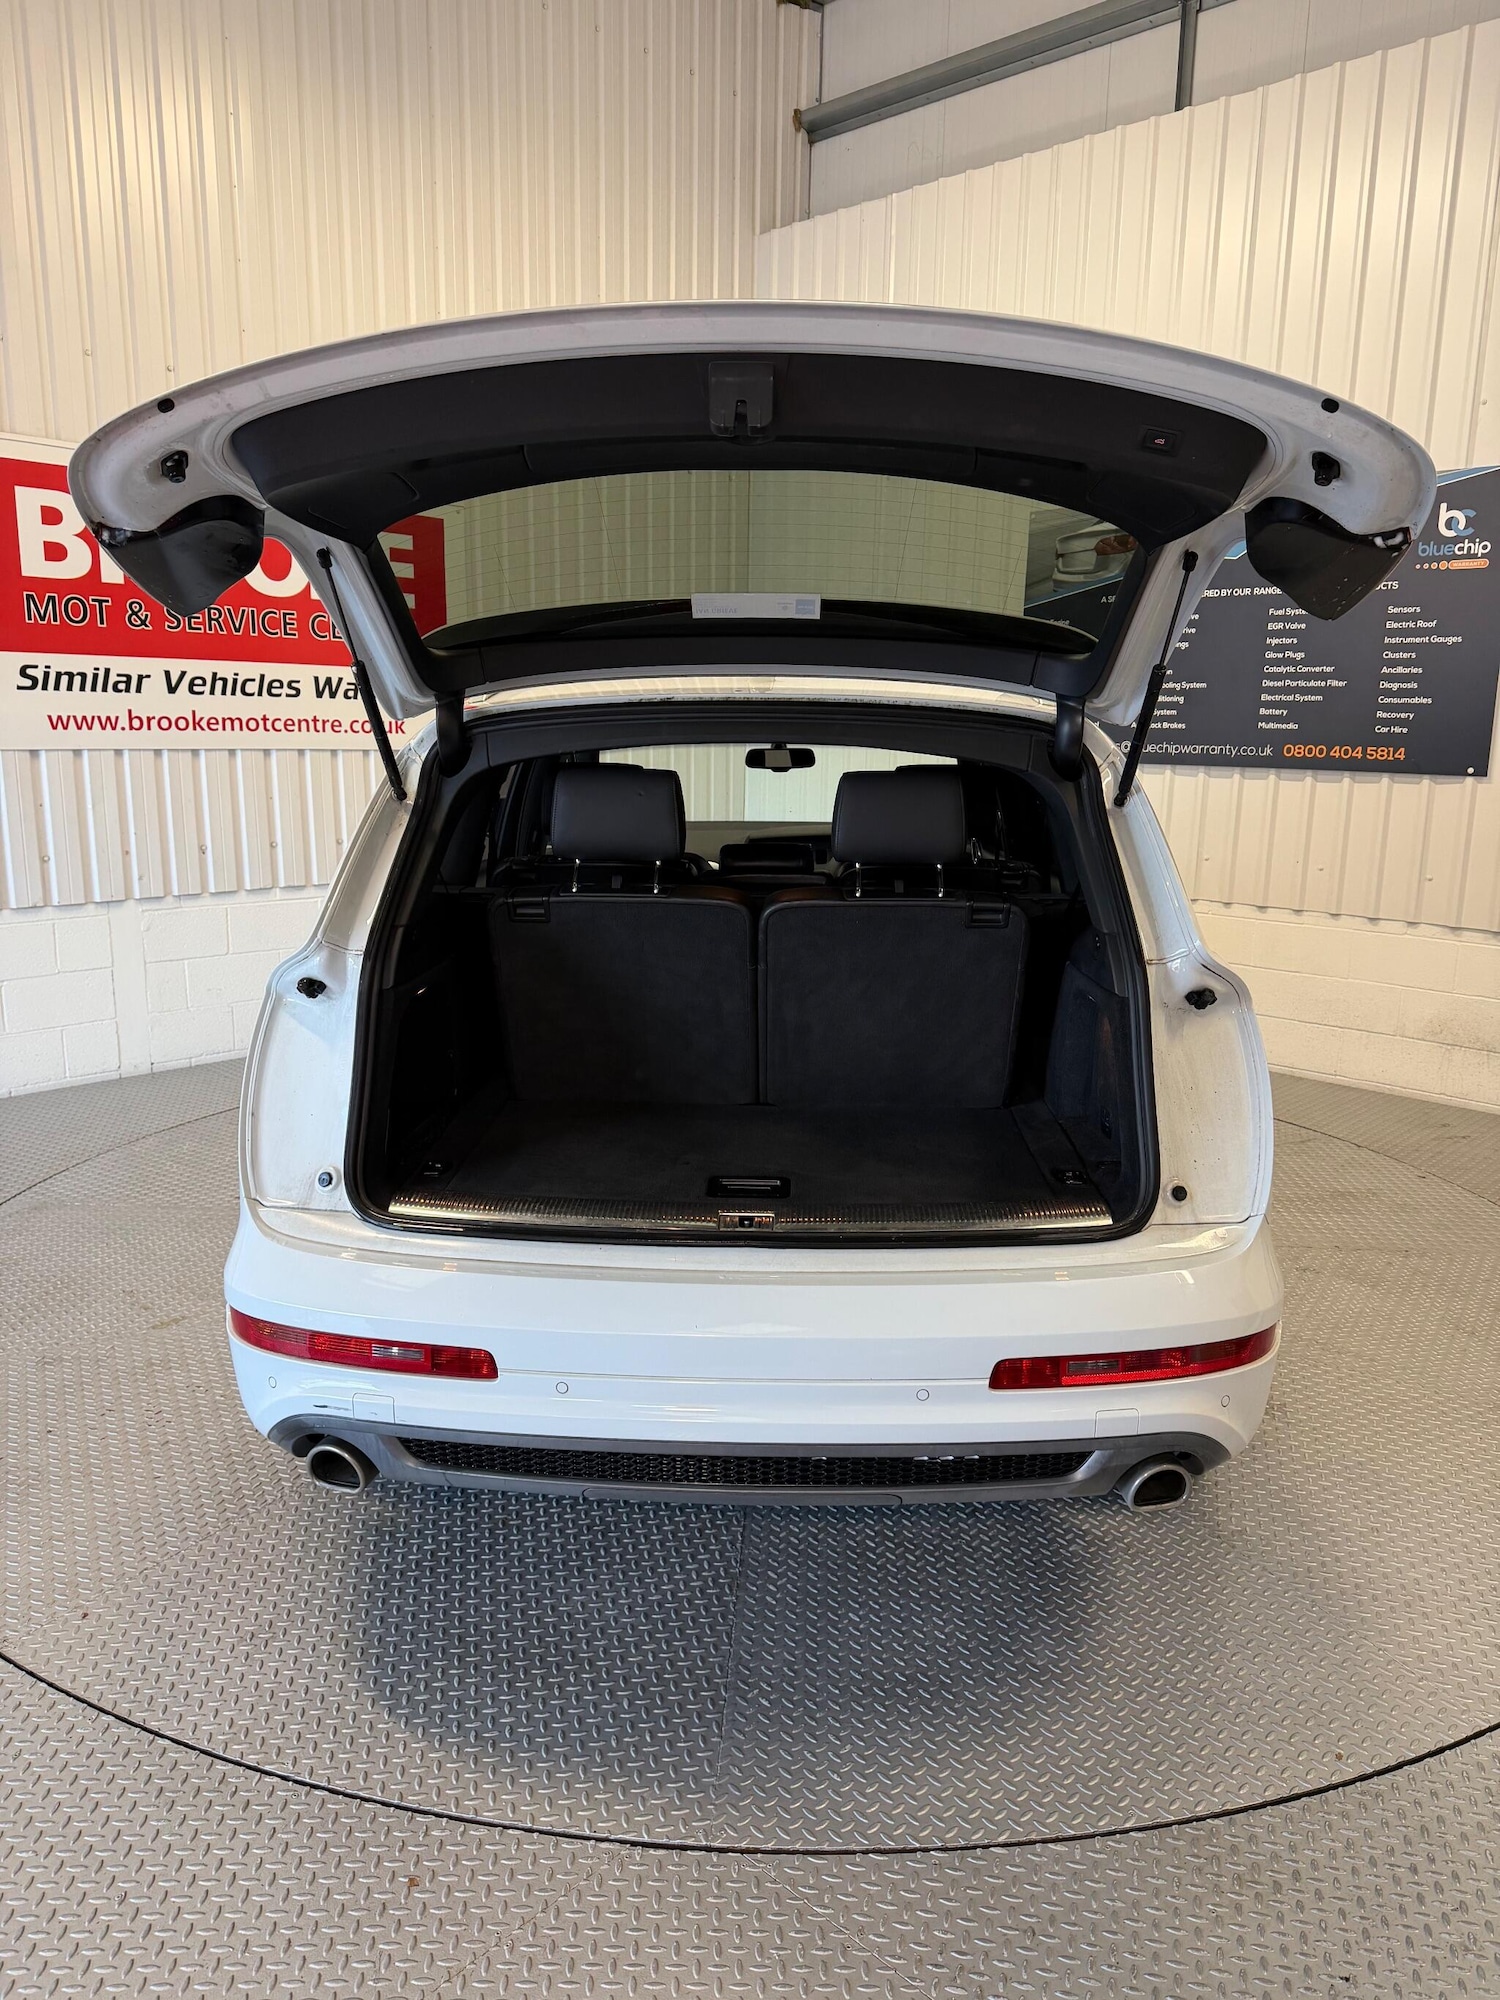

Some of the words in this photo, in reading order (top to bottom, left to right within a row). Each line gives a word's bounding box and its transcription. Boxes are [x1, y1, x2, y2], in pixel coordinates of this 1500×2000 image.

[1418, 538, 1492, 558] bluechip
[1220, 588, 1233, 597] BY
[1233, 587, 1251, 596] OUR
[1268, 608, 1285, 616] Fuel
[1285, 607, 1309, 617] Syste
[1387, 605, 1421, 614] Sensors
[23, 591, 112, 628] MOT
[126, 598, 152, 631] &
[164, 604, 299, 639] SERVICE
[1267, 622, 1284, 630] EGR
[1285, 622, 1307, 630] Valve
[1385, 621, 1416, 629] Electric
[1416, 620, 1438, 628] Roof
[1182, 626, 1197, 634] rive
[1266, 637, 1298, 647] Injectors
[1384, 636, 1430, 644] Instrument
[1430, 635, 1463, 646] Gauges
[1264, 651, 1284, 659] Glow
[1284, 650, 1306, 661] Plugs
[1382, 651, 1417, 659] Clusters
[1263, 665, 1296, 674] Catalytic
[1296, 665, 1336, 673] Converter
[1380, 666, 1423, 674] Ancillaries
[16, 664, 152, 694] Similar
[163, 669, 301, 698] Vehicles
[1181, 681, 1207, 690] System
[1262, 679, 1285, 688] Diesel
[1284, 679, 1326, 688] Particulate
[1326, 679, 1348, 687] Filter
[1379, 681, 1418, 691] Diagnosis
[1260, 693, 1294, 701] Electrical
[1294, 693, 1324, 703] System
[1378, 695, 1433, 705] Consumables
[1259, 707, 1288, 717] Battery
[1376, 710, 1415, 721] Recovery
[47, 708, 406, 735] www.brookemotcentre.couk
[1162, 721, 1186, 730] Brakes
[1257, 721, 1299, 730] Multimedia
[1374, 725, 1390, 733] Car
[1390, 725, 1409, 734] Hire
[1283, 743, 1327, 758] 0800
[1329, 745, 1363, 759] 404
[1366, 746, 1406, 760] 5814
